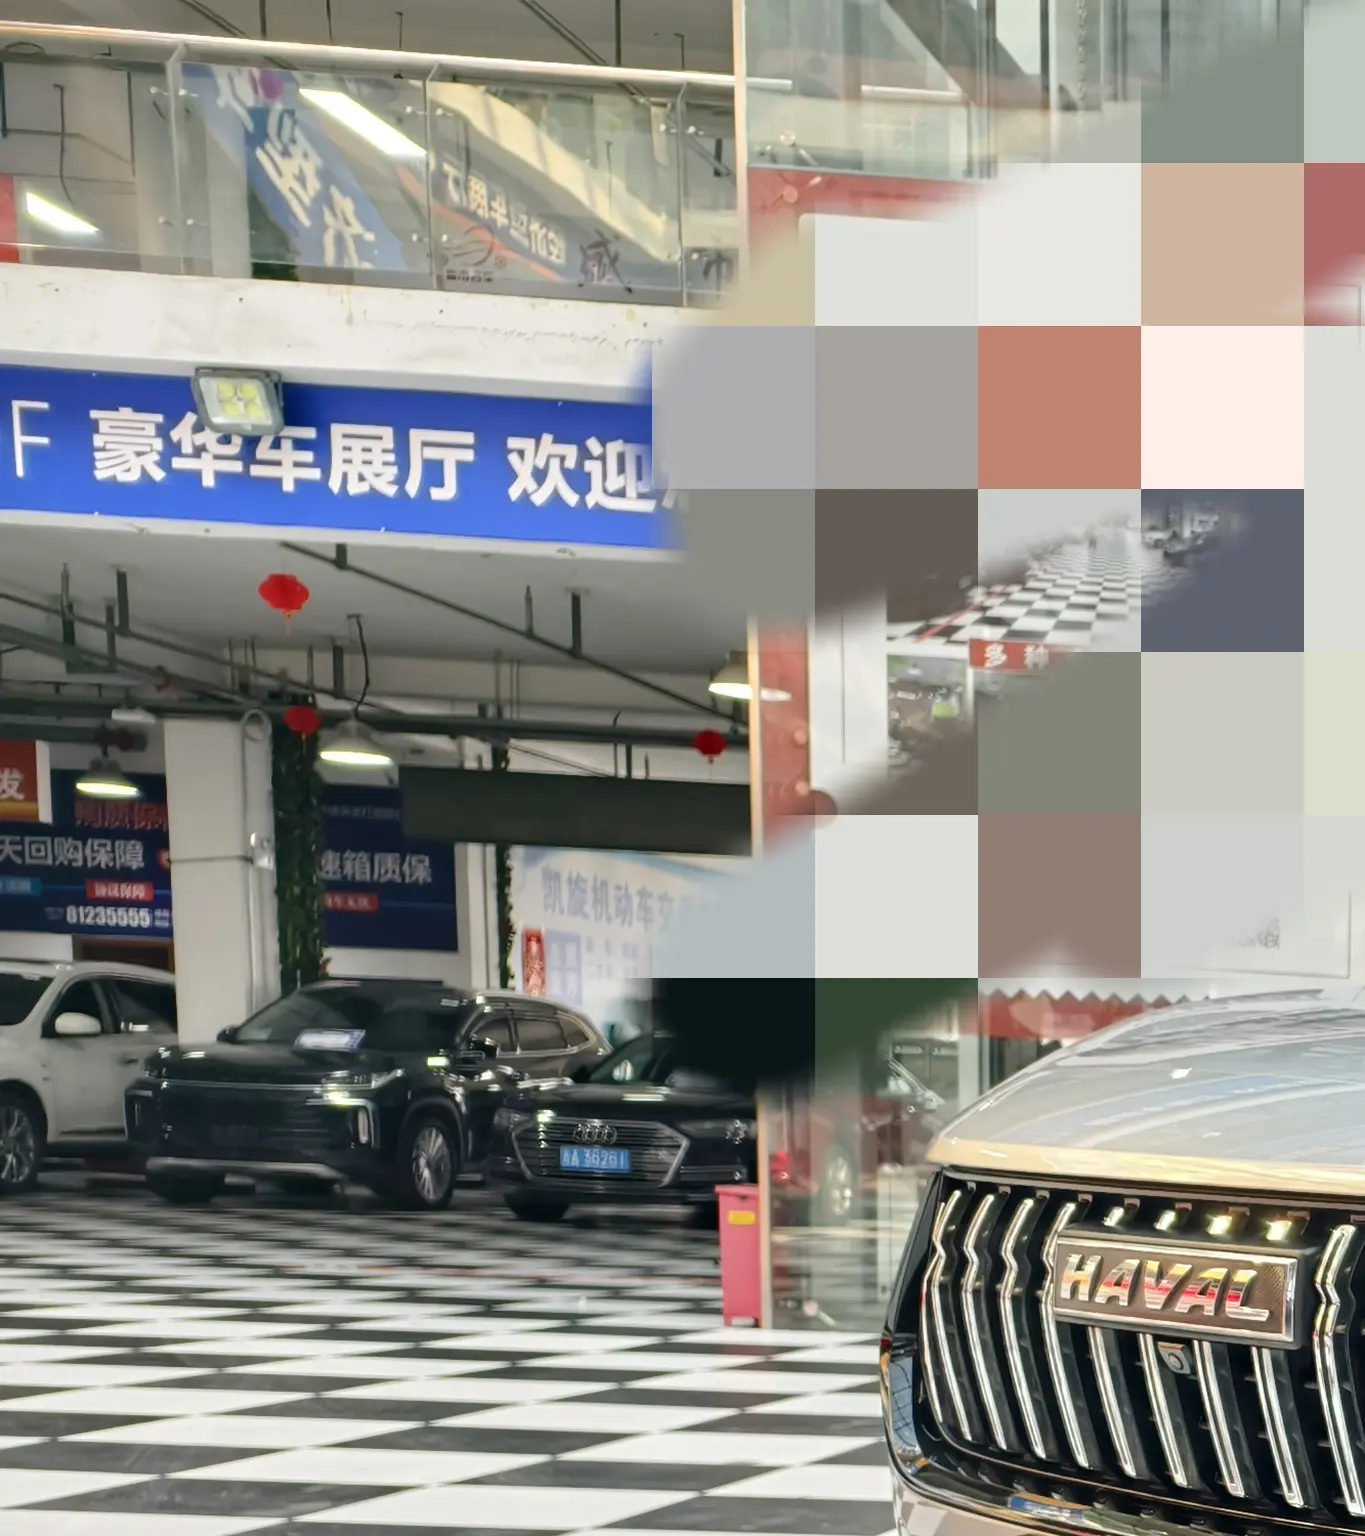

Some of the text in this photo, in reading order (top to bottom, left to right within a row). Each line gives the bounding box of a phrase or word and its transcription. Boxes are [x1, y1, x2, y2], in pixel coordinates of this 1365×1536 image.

[12, 400, 690, 514] F 豪华车展厅 欢迎
[1060, 1253, 1270, 1322] HAVAL
